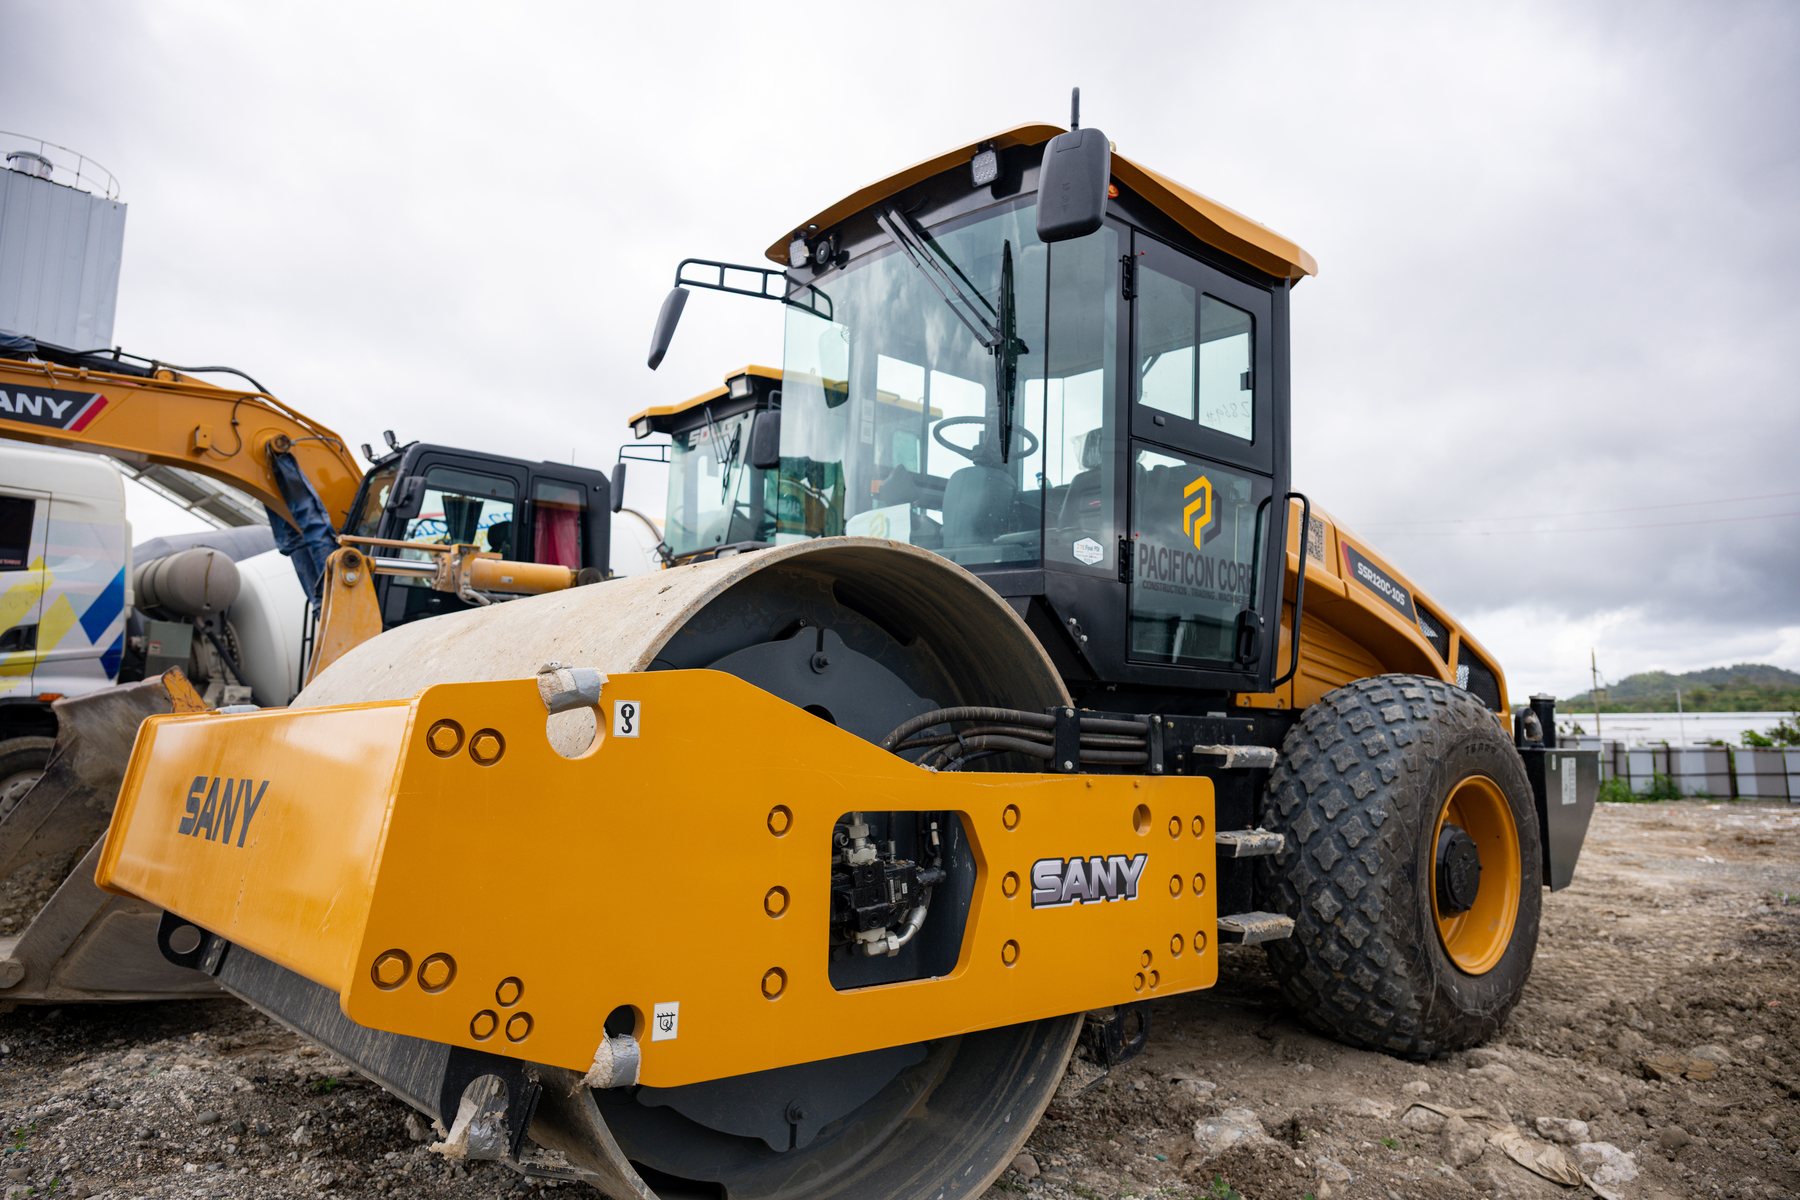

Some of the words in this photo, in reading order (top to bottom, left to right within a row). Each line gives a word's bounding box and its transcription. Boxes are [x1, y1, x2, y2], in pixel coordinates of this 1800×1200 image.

[0, 390, 73, 419] ANY
[1138, 543, 1214, 589] PACIFICON
[1142, 580, 1187, 596] CONSTRUCTION
[1357, 561, 1405, 606] SSR120C-10S
[178, 776, 270, 848] SANY
[1031, 853, 1148, 908] SANY
